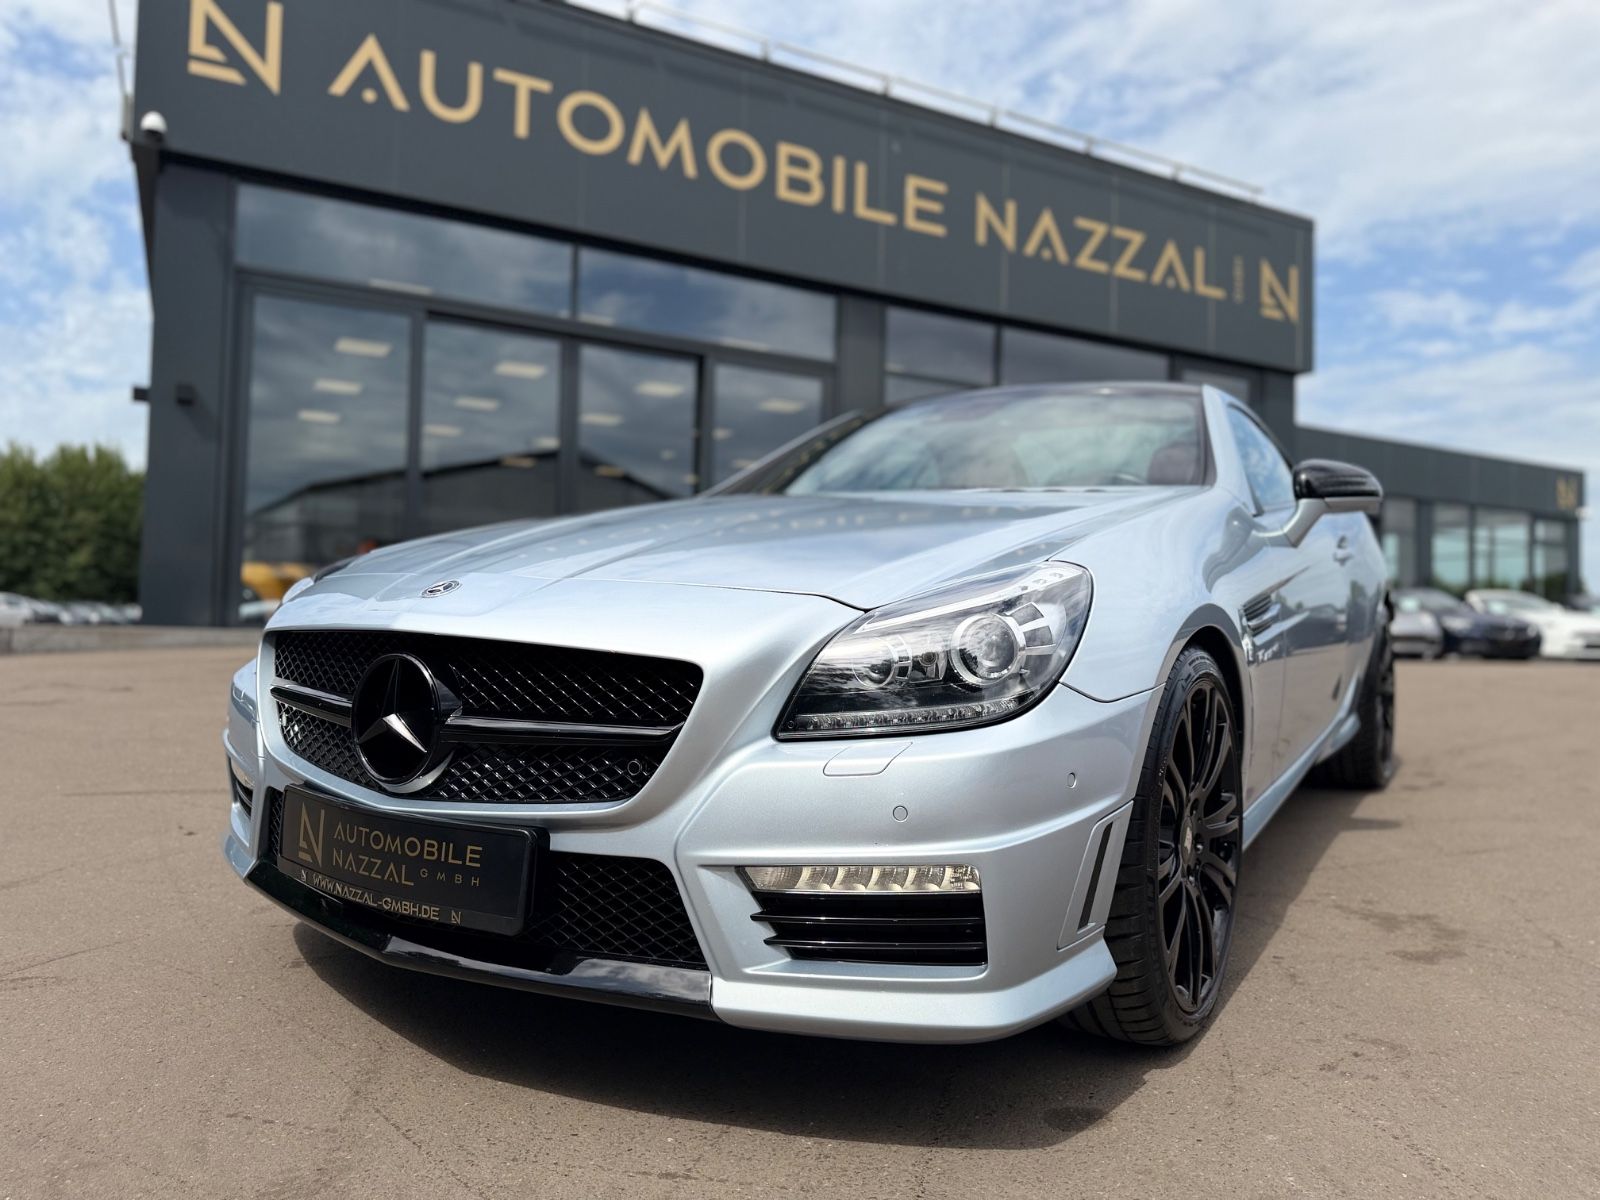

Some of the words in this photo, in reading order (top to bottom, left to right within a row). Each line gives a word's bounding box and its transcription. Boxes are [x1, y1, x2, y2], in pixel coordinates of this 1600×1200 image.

[328, 33, 948, 237] AUTOMOBILE
[975, 192, 1227, 300] NAZZAL
[333, 821, 483, 868] AUTOMOBILE
[333, 848, 414, 886] NAZZAL
[313, 873, 440, 921] WWW.NAZZAL-GMBH.DE
